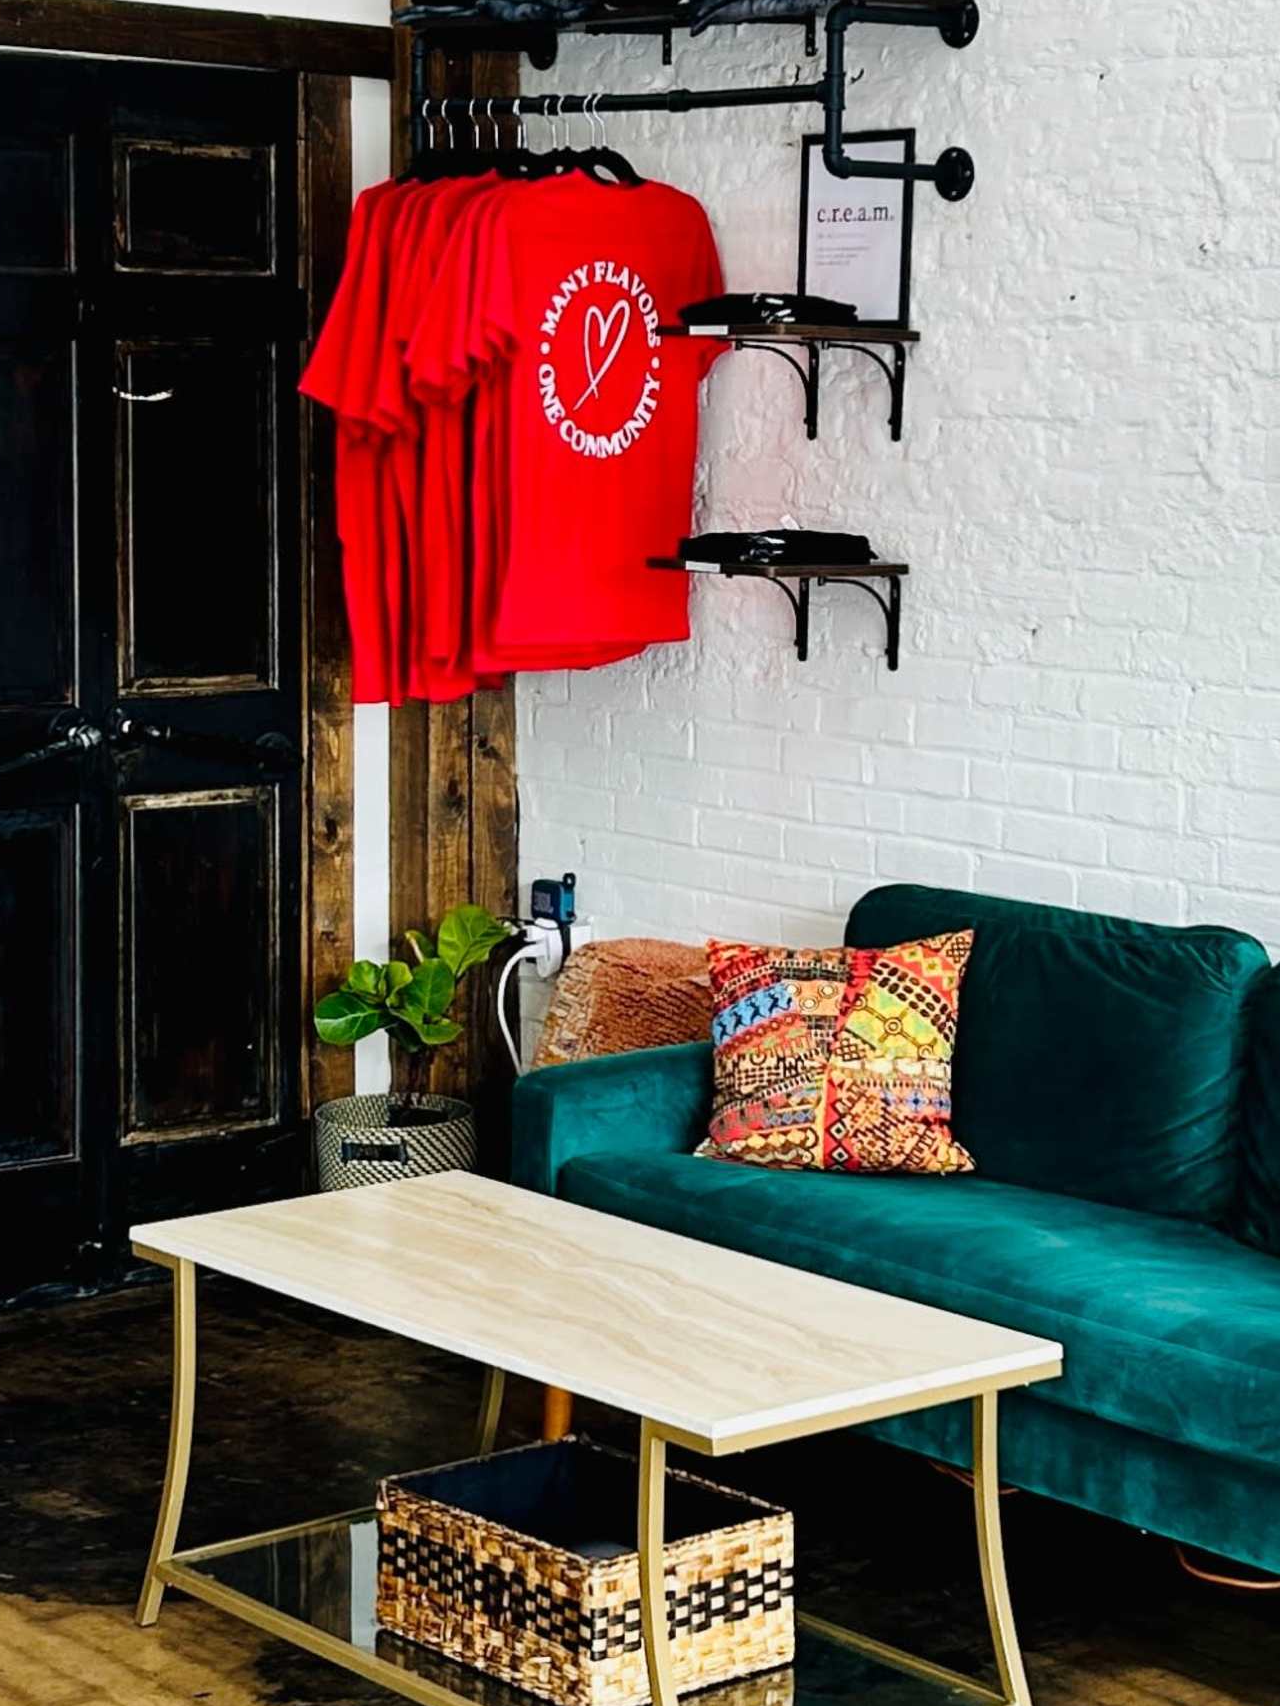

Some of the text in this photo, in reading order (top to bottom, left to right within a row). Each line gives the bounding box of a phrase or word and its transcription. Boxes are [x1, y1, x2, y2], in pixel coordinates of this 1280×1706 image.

[816, 204, 895, 223] c.r.e.a.m.
[540, 260, 661, 349] MANY FLAVORS
[538, 362, 661, 459] ONE COMMUNITY
